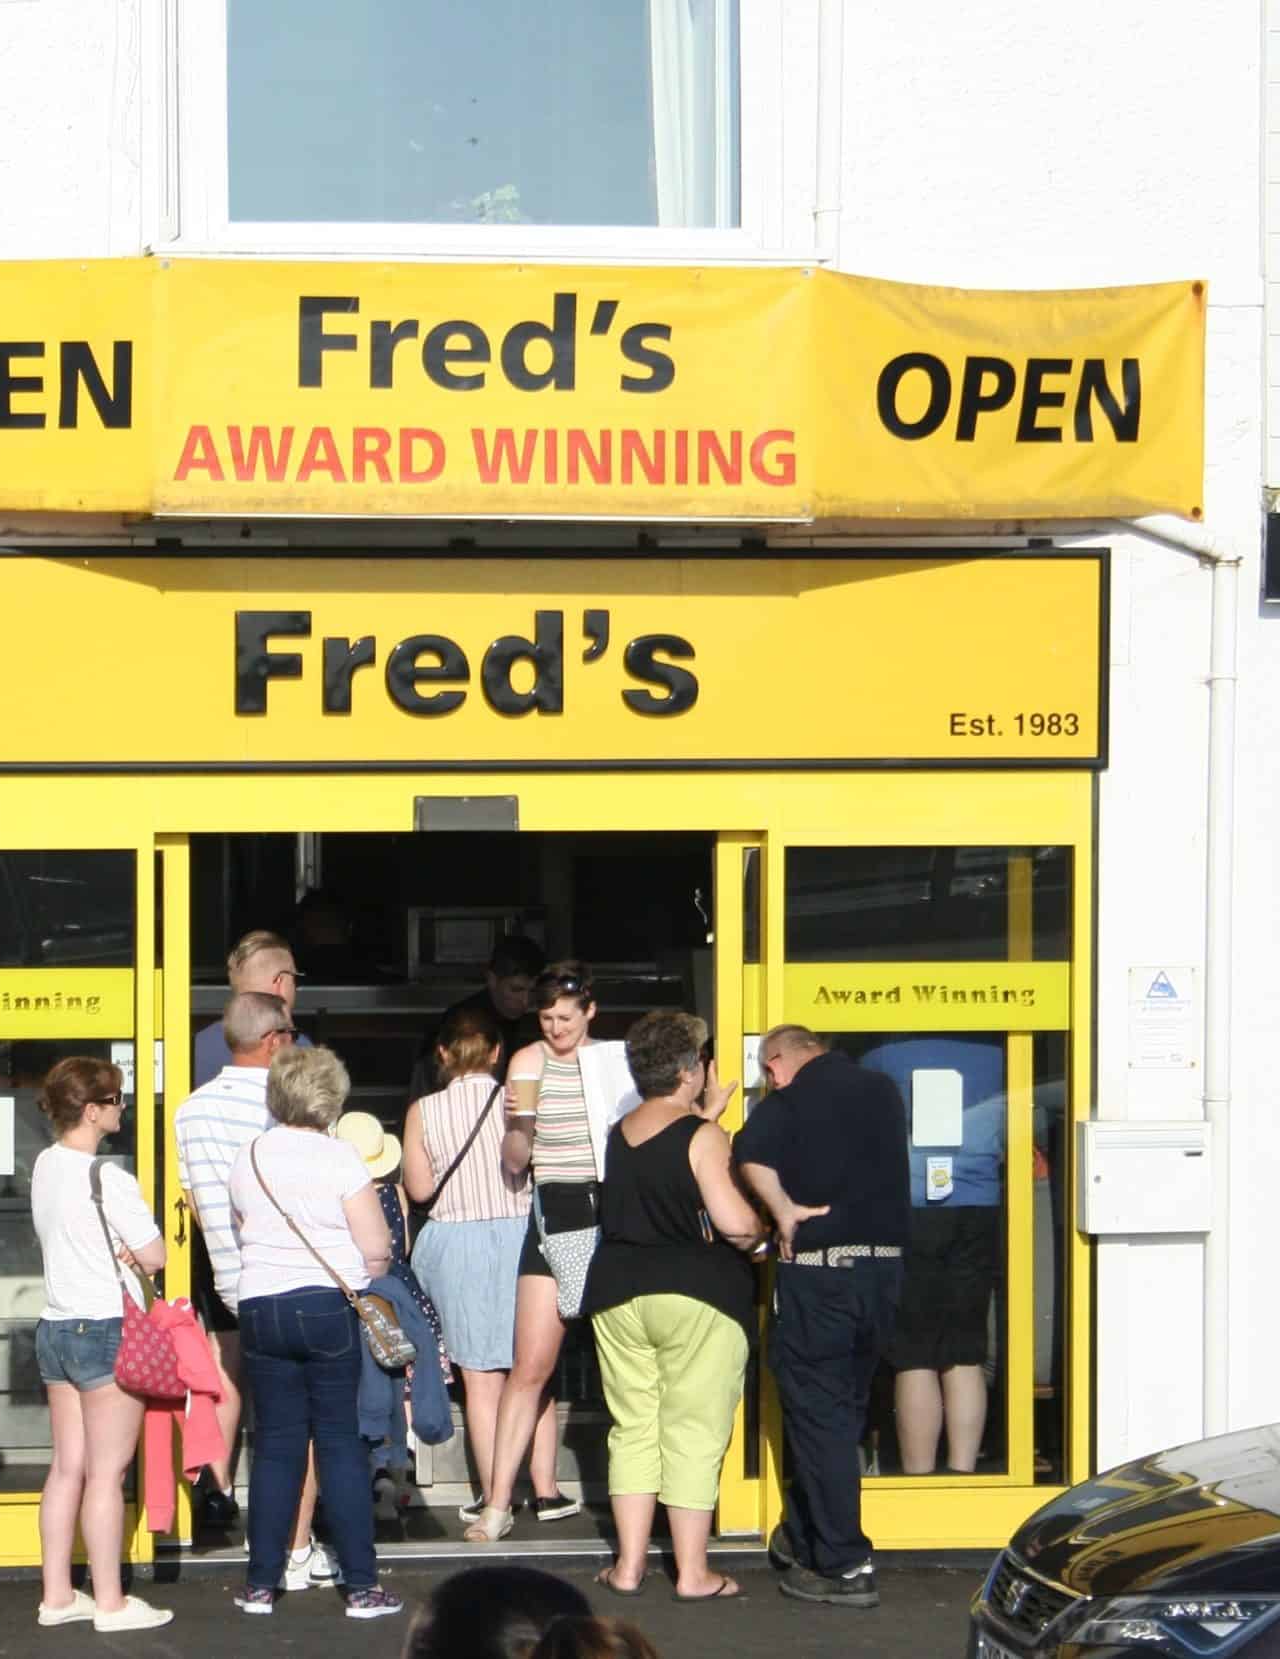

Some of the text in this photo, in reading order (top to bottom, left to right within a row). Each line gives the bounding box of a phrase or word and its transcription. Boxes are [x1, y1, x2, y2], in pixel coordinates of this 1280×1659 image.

[299, 292, 675, 393] Fred's
[877, 352, 1141, 443] OPEN
[174, 425, 796, 486] AWARD WINNING
[235, 610, 700, 717] Fred's
[950, 713, 1080, 737] Est. 1983
[814, 985, 1036, 1007] Award Winning
